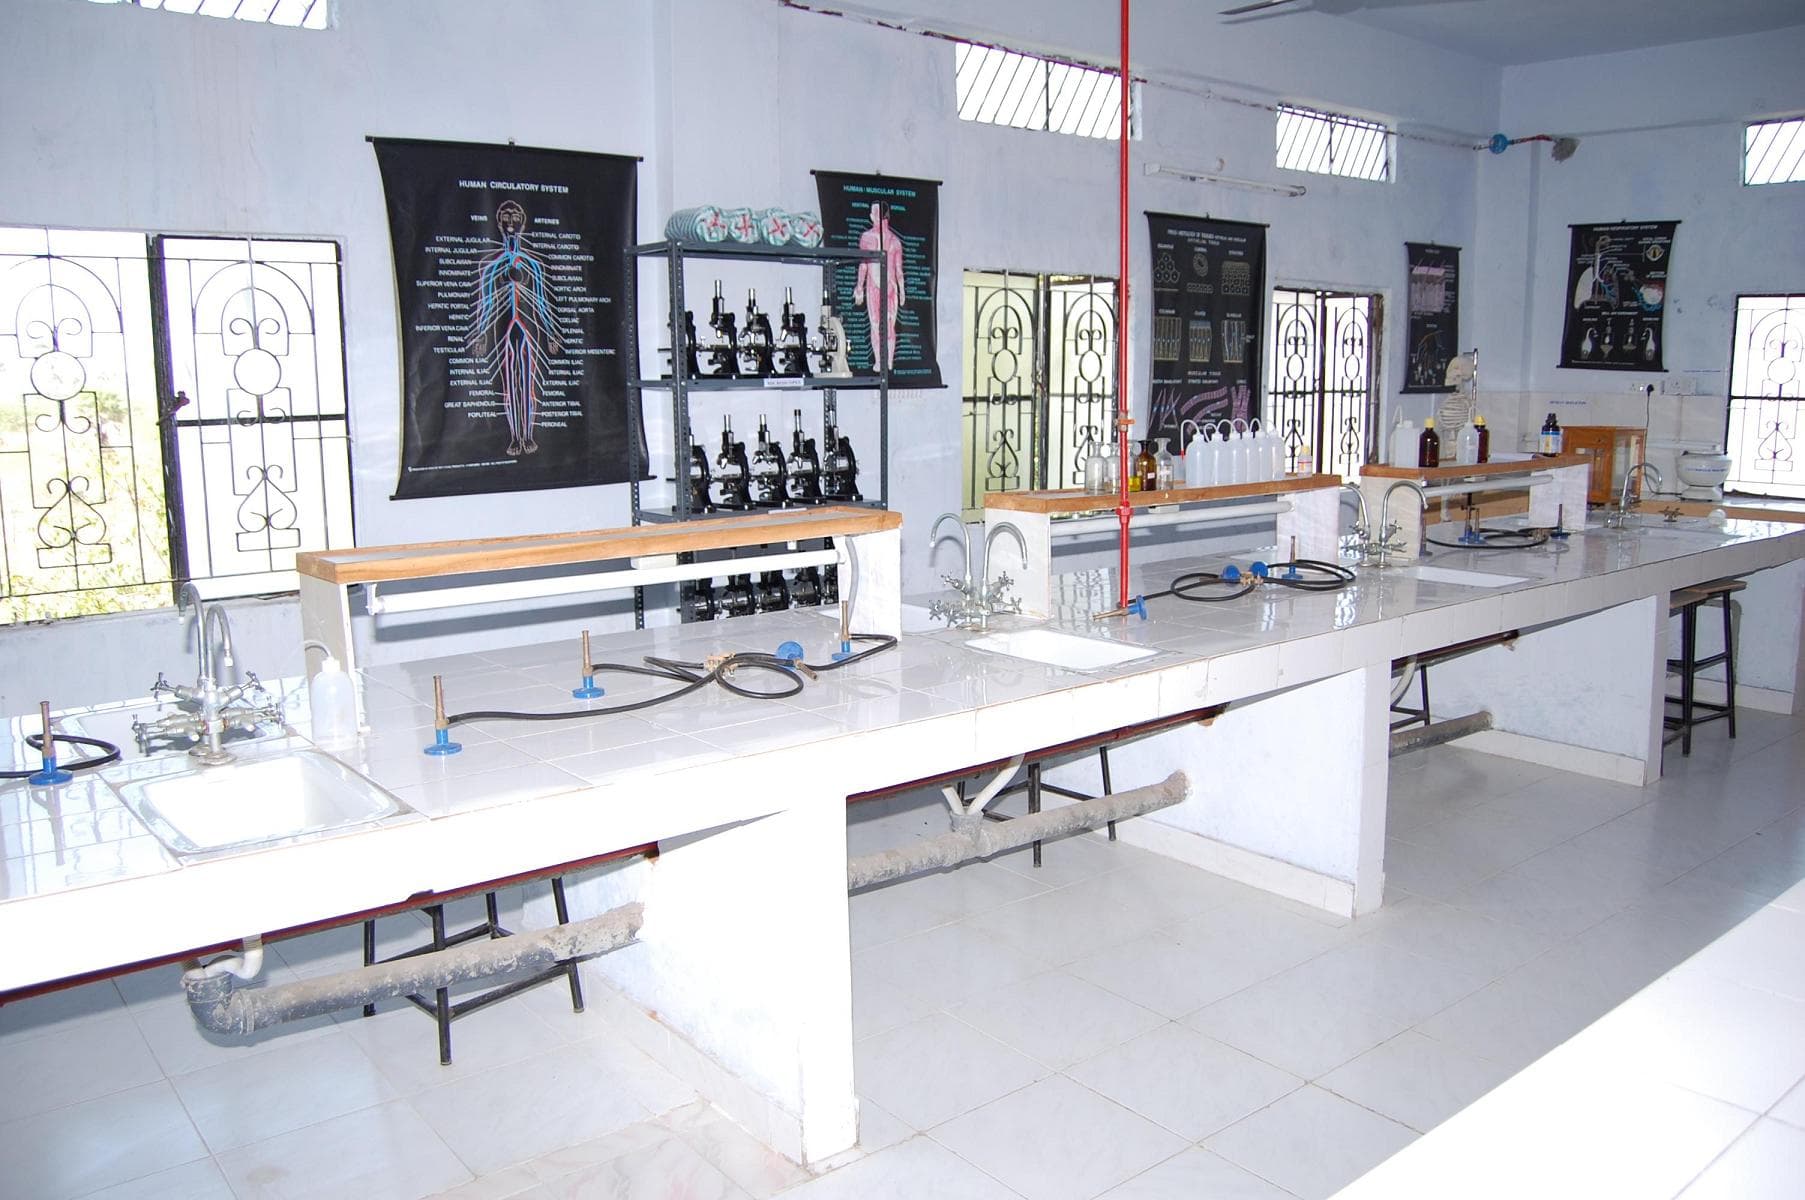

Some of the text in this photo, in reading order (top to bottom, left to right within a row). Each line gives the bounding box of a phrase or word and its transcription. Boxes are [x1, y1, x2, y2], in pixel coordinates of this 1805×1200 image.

[459, 180, 569, 193] HUMAN CIRCULATORY SYSTEM
